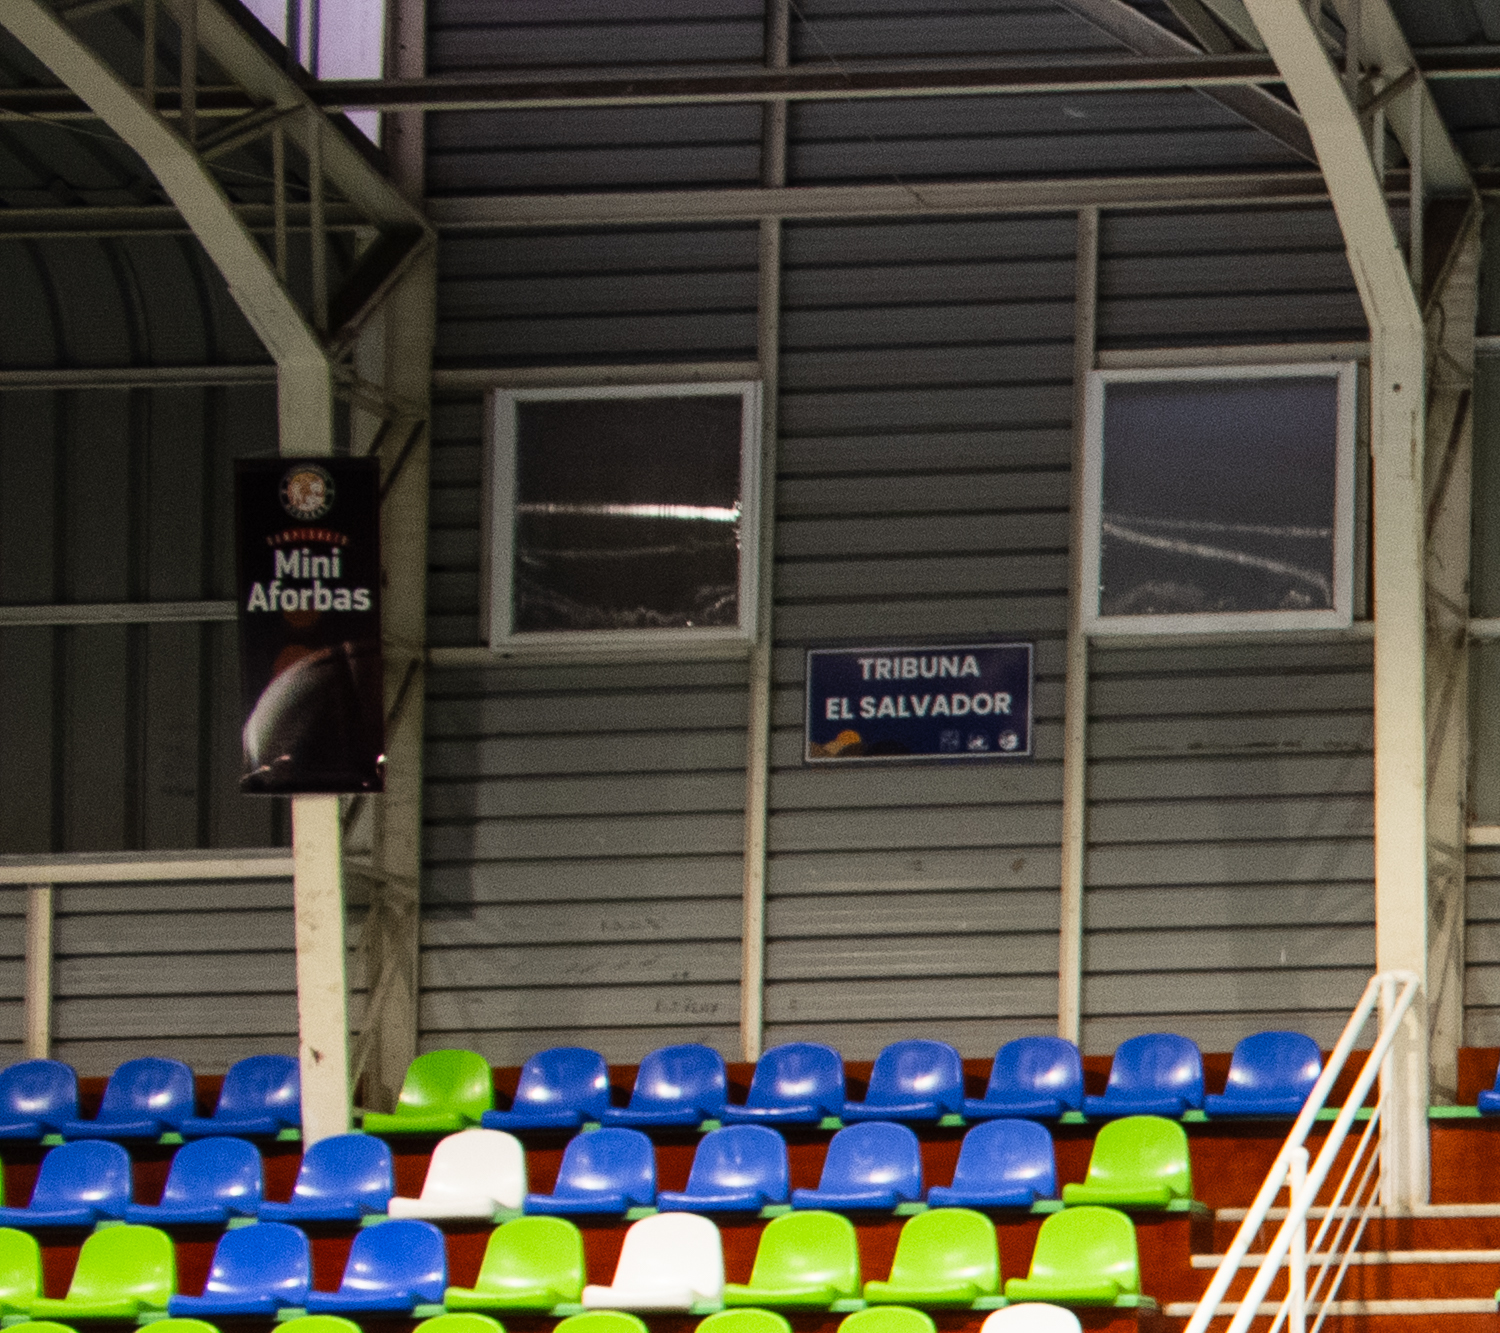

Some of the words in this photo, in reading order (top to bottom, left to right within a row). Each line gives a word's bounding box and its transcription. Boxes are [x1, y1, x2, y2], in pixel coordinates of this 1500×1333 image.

[274, 547, 341, 578] Mini
[246, 580, 372, 612] Aforbas
[858, 655, 981, 680] TRIBUNA
[825, 697, 854, 720] EL
[859, 691, 1012, 719] SALVADOR
